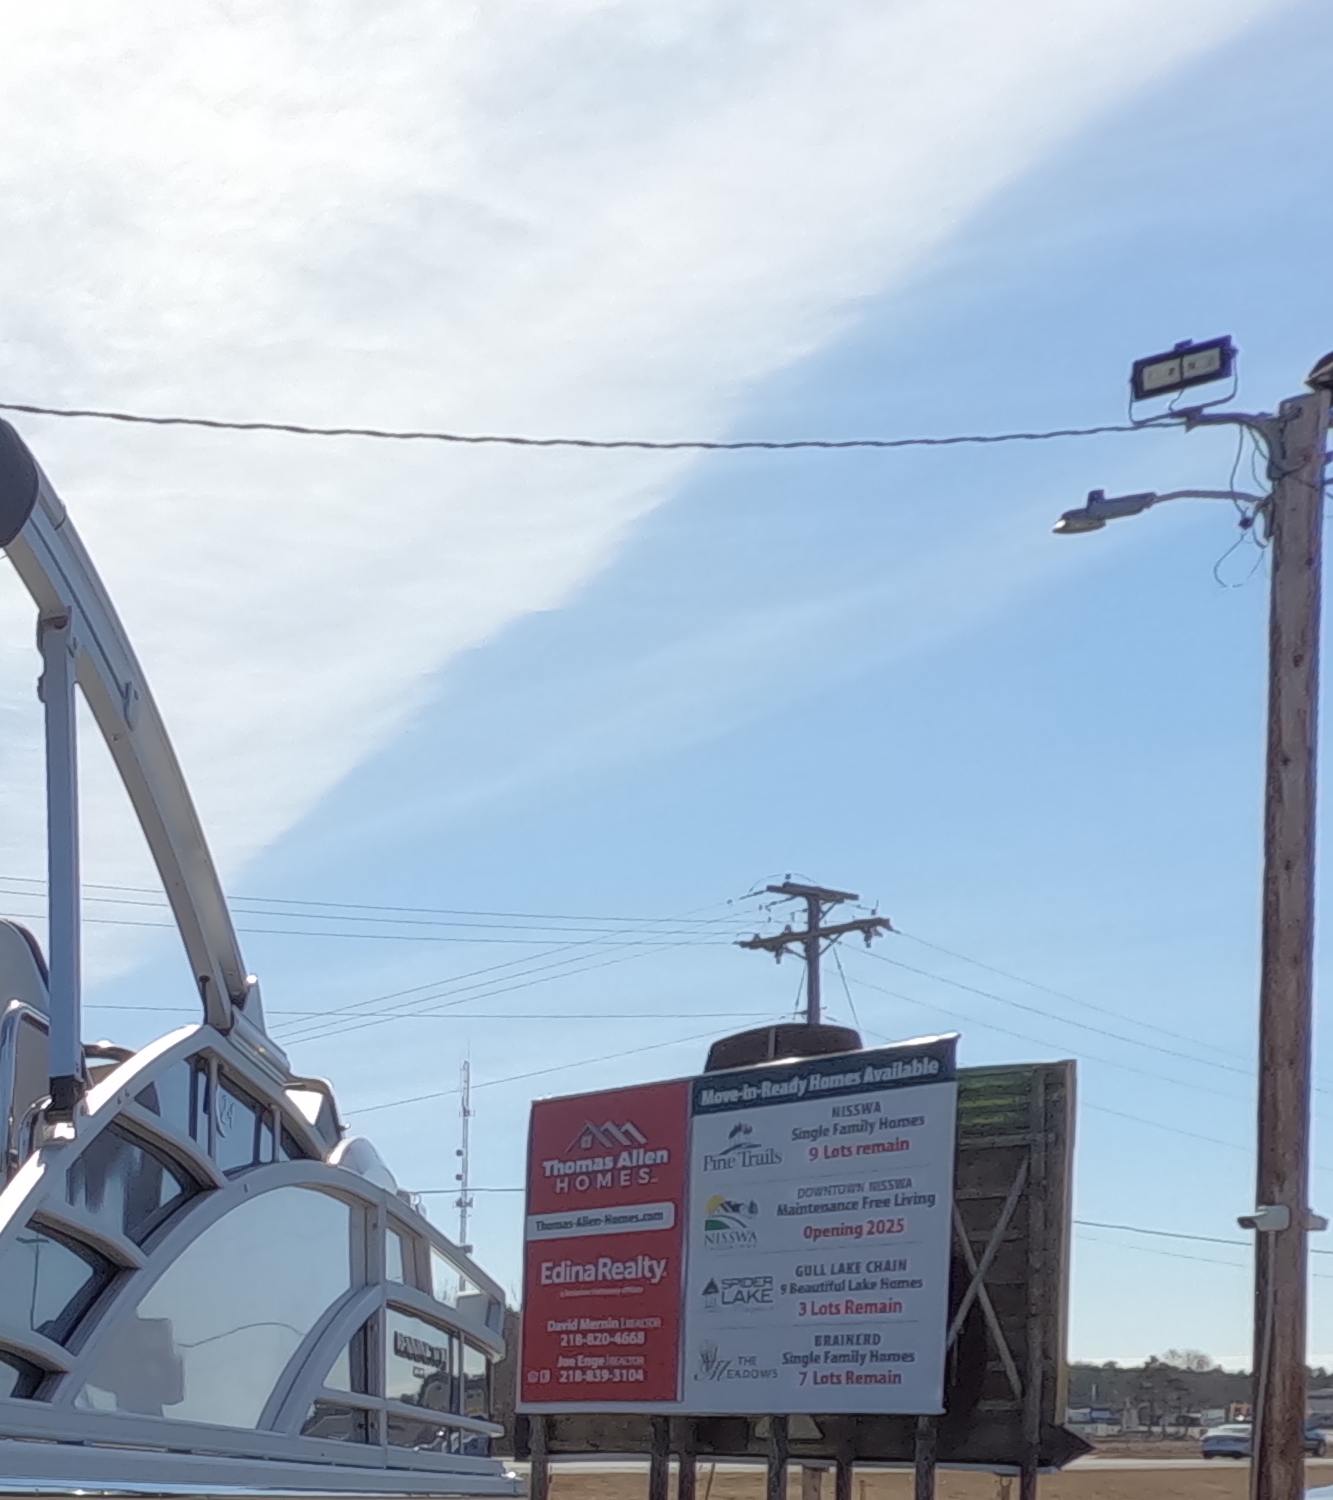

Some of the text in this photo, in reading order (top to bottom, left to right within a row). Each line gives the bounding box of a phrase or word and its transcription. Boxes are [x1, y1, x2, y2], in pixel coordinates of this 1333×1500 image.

[701, 1057, 939, 1106] Move-in-Ready Homes Available
[832, 1101, 881, 1118] NISSWA
[792, 1114, 925, 1142] Single Family Homes
[738, 1148, 782, 1169] Trails
[809, 1138, 910, 1162] 9 Lots remain
[542, 1148, 669, 1177] Thomas Allen
[555, 1168, 651, 1193] HOMES
[797, 1182, 865, 1199] DOWNTOWN
[777, 1193, 936, 1216] Maintenance Free Living
[704, 1231, 758, 1245] NISSWA
[803, 1218, 904, 1242] Opening 2025
[795, 1258, 908, 1278] GULL LAKE CHAIN
[789, 1279, 846, 1294] Beautiful
[848, 1279, 876, 1292] Lake
[880, 1277, 923, 1289] Homes
[721, 1289, 774, 1305] LAKE
[798, 1298, 903, 1317] 3 Lots Remain
[547, 1319, 578, 1332] David
[738, 1356, 757, 1367] THE
[782, 1350, 915, 1368] Single Family Homes
[798, 1369, 902, 1386] 7 Lots Remain
